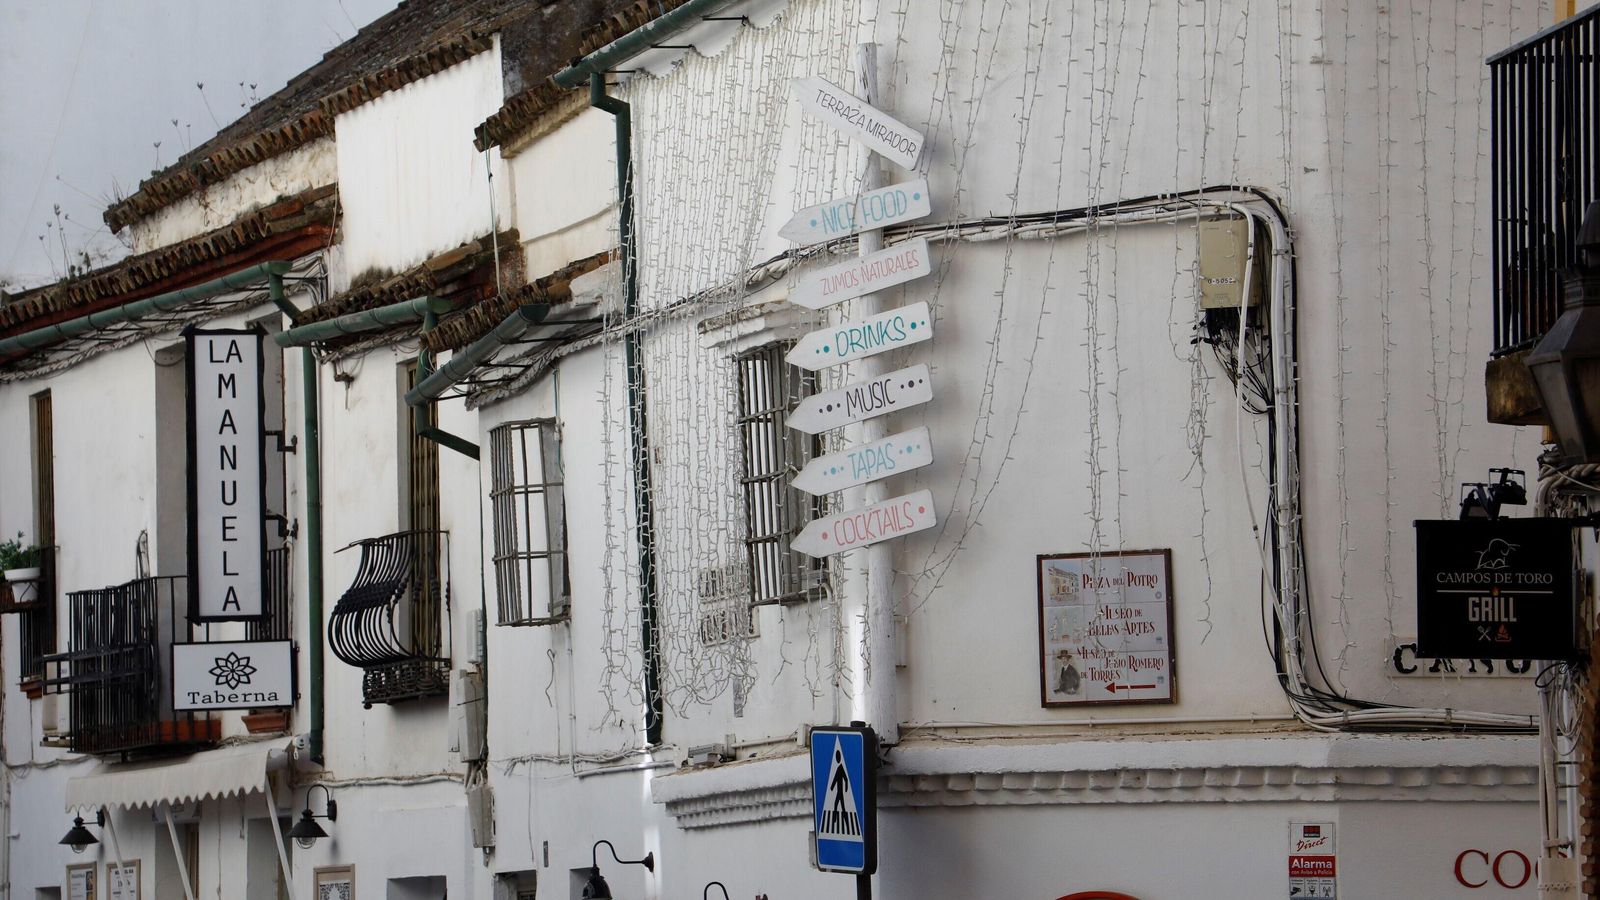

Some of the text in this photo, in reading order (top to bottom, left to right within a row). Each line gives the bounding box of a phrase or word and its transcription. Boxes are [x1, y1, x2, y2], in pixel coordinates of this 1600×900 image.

[816, 89, 917, 159] TERRAZA MIRADOR
[820, 189, 908, 235] NICE FOOD
[820, 249, 920, 297] ZUMOS NATURALES
[835, 316, 907, 357] DRINKS
[209, 339, 243, 364] LA
[845, 378, 896, 418] MUSIC
[847, 443, 896, 480] TAPAS
[833, 501, 915, 546] COCKTAILS
[1082, 573, 1111, 589] PLZA
[1127, 571, 1158, 589] POTRO
[1436, 572, 1554, 584] CAMPOS DE TORO
[1134, 608, 1143, 617] DE
[1468, 597, 1518, 622] GRILL
[1121, 620, 1156, 637] ARTES
[1089, 667, 1121, 683] TORRES
[1128, 655, 1164, 672] ROMERO
[187, 690, 280, 705] Taberna
[1291, 858, 1333, 869] Alarma
